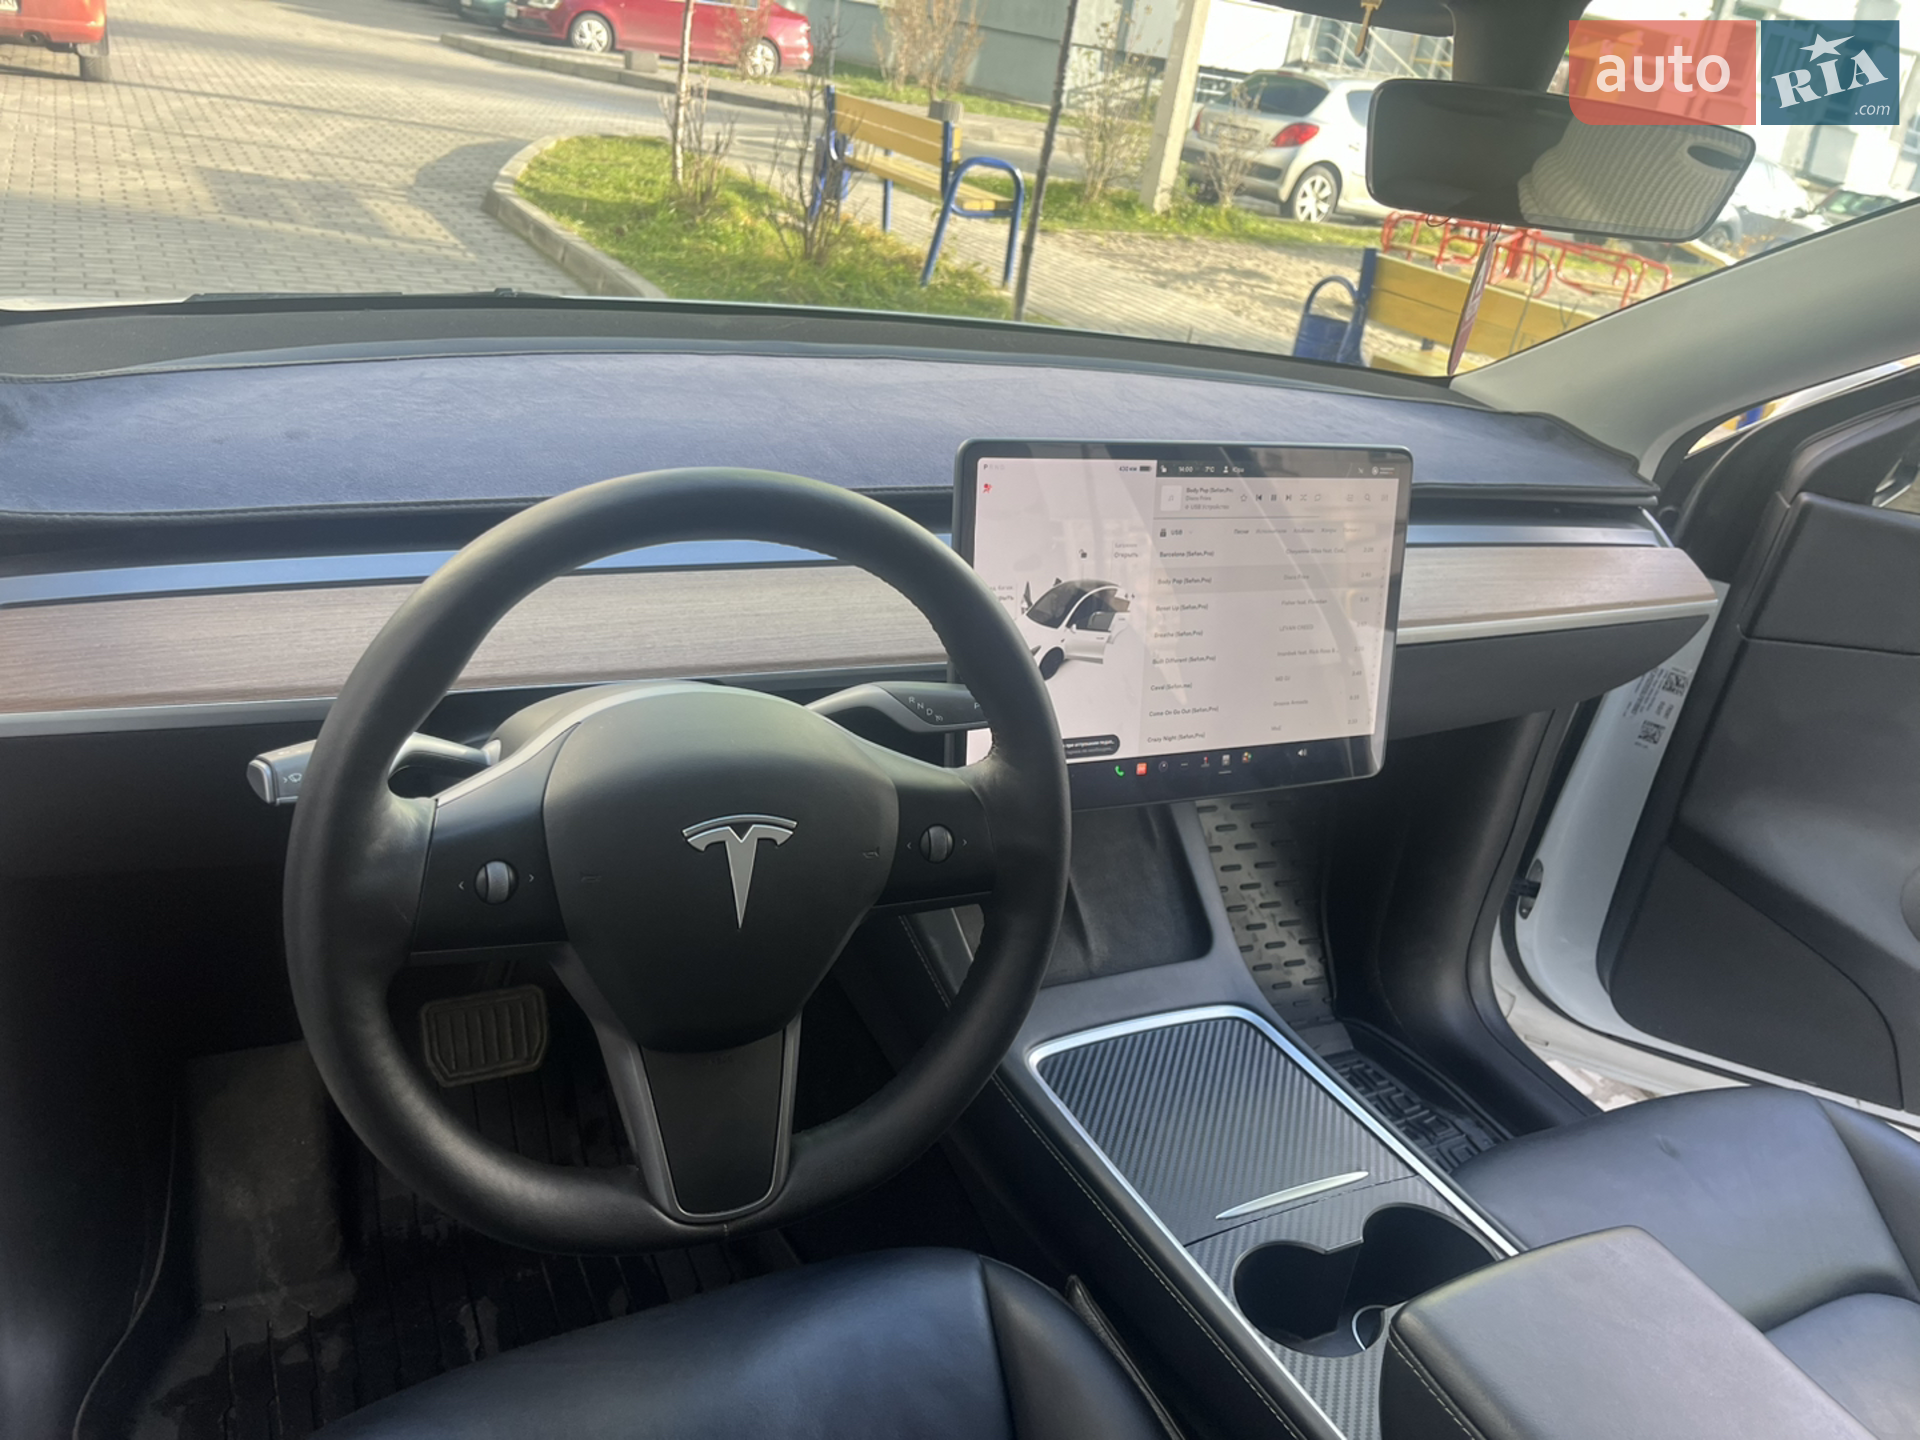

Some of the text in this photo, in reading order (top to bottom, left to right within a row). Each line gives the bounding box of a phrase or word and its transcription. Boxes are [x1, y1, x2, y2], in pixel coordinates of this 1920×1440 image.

[909, 696, 933, 716] R N D
